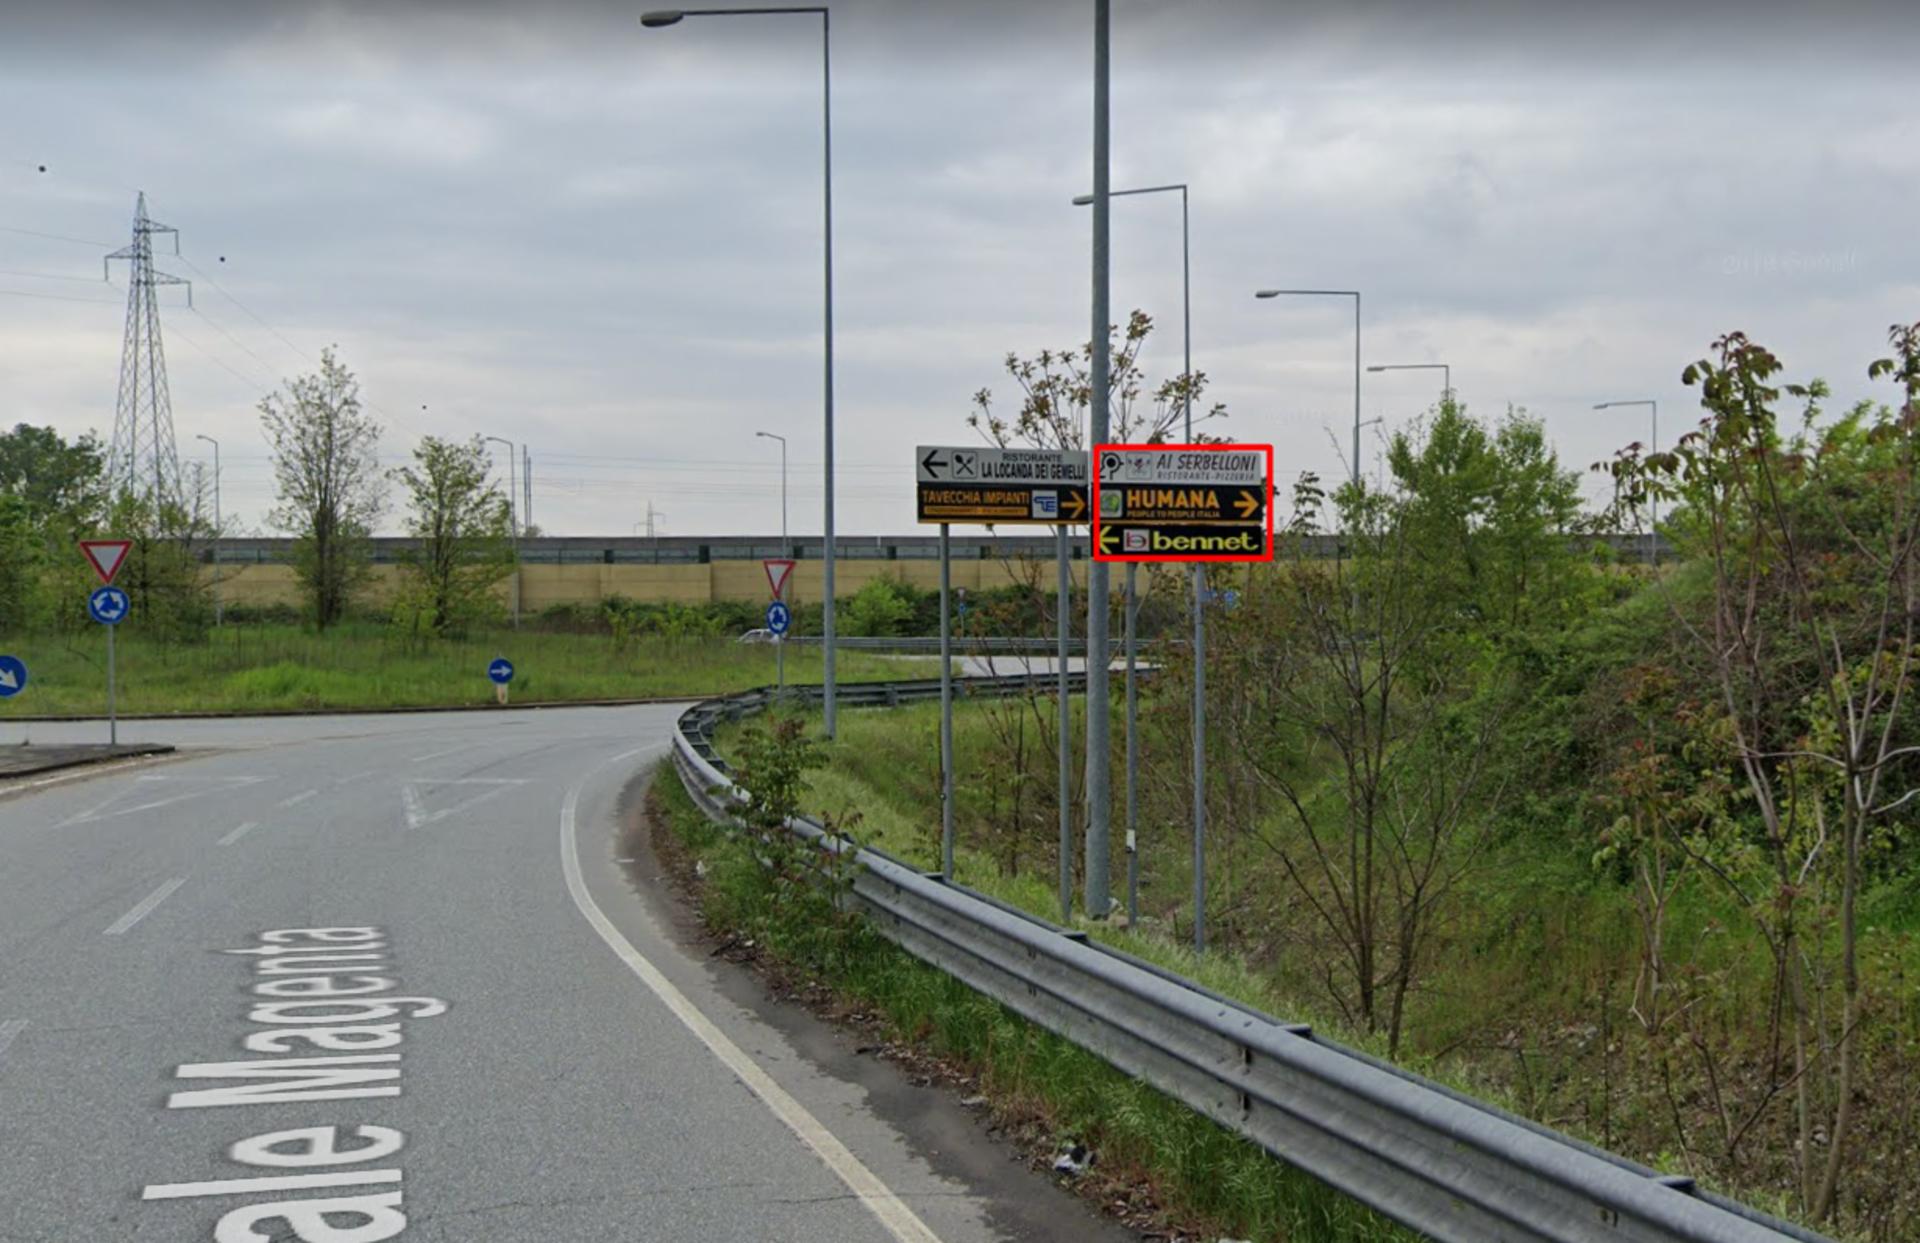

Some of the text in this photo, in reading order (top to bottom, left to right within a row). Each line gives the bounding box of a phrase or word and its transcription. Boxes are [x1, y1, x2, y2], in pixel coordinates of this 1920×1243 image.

[1002, 452, 1063, 462] RISTORANTE
[1157, 454, 1257, 471] AI SERBELLONI
[981, 462, 1086, 480] LA LOCANDA DEI GEMELLI
[922, 490, 1030, 505] TAVECCHIA IMPIANTI
[1127, 490, 1220, 508] HUMANA
[1153, 531, 1259, 551] bennet
